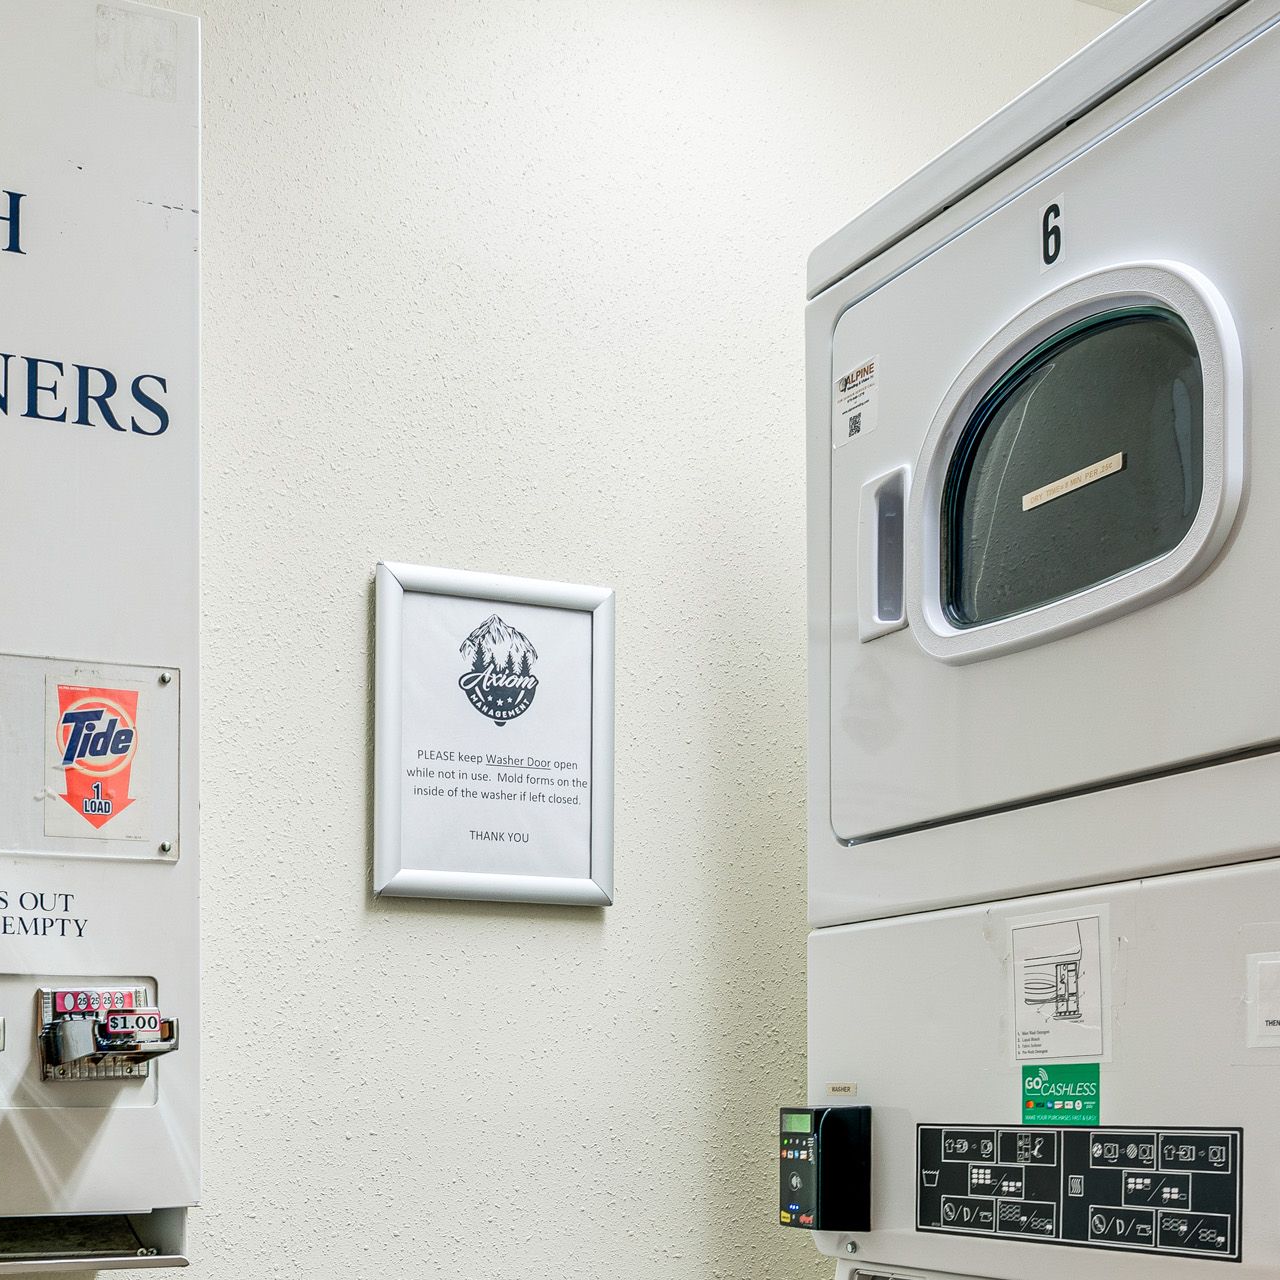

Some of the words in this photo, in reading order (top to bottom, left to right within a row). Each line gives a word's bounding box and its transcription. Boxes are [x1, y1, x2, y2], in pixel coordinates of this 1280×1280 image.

[1042, 203, 1062, 265] 6
[846, 362, 875, 386] ALPINE
[1085, 469, 1098, 479] PER
[461, 664, 538, 691] Axiom
[470, 693, 531, 718] MANAGEMENT
[62, 709, 134, 765] Tide
[417, 749, 455, 762] PLEASE
[458, 752, 483, 765] keep
[486, 753, 524, 766] Washer
[528, 755, 551, 768] Door
[554, 759, 578, 771] open
[407, 767, 435, 779] while
[438, 769, 455, 780] not
[459, 769, 468, 780] in
[471, 773, 493, 783] use.
[497, 772, 523, 784] Mold
[525, 773, 555, 786] forms
[557, 777, 569, 787] on
[572, 776, 588, 788] the
[92, 782, 102, 801] 1
[413, 785, 444, 797] inside
[447, 786, 459, 798] of
[461, 787, 478, 799] the
[481, 790, 517, 801] washer
[520, 789, 527, 802] if
[529, 790, 546, 803] left
[548, 792, 582, 805] closed.
[84, 800, 112, 814] LOAD
[469, 829, 505, 842] THANK
[508, 831, 529, 843] YOU
[19, 891, 75, 912] OUT
[1, 916, 89, 937] EMPTY
[78, 997, 88, 1005] 25
[91, 996, 101, 1005] 25
[103, 996, 112, 1005] 25
[115, 996, 124, 1004] 25
[110, 1015, 158, 1030] $1.00
[1265, 1019, 1280, 1027] THEN
[1025, 1077, 1042, 1089] GO
[1041, 1083, 1097, 1096] CASHLESS
